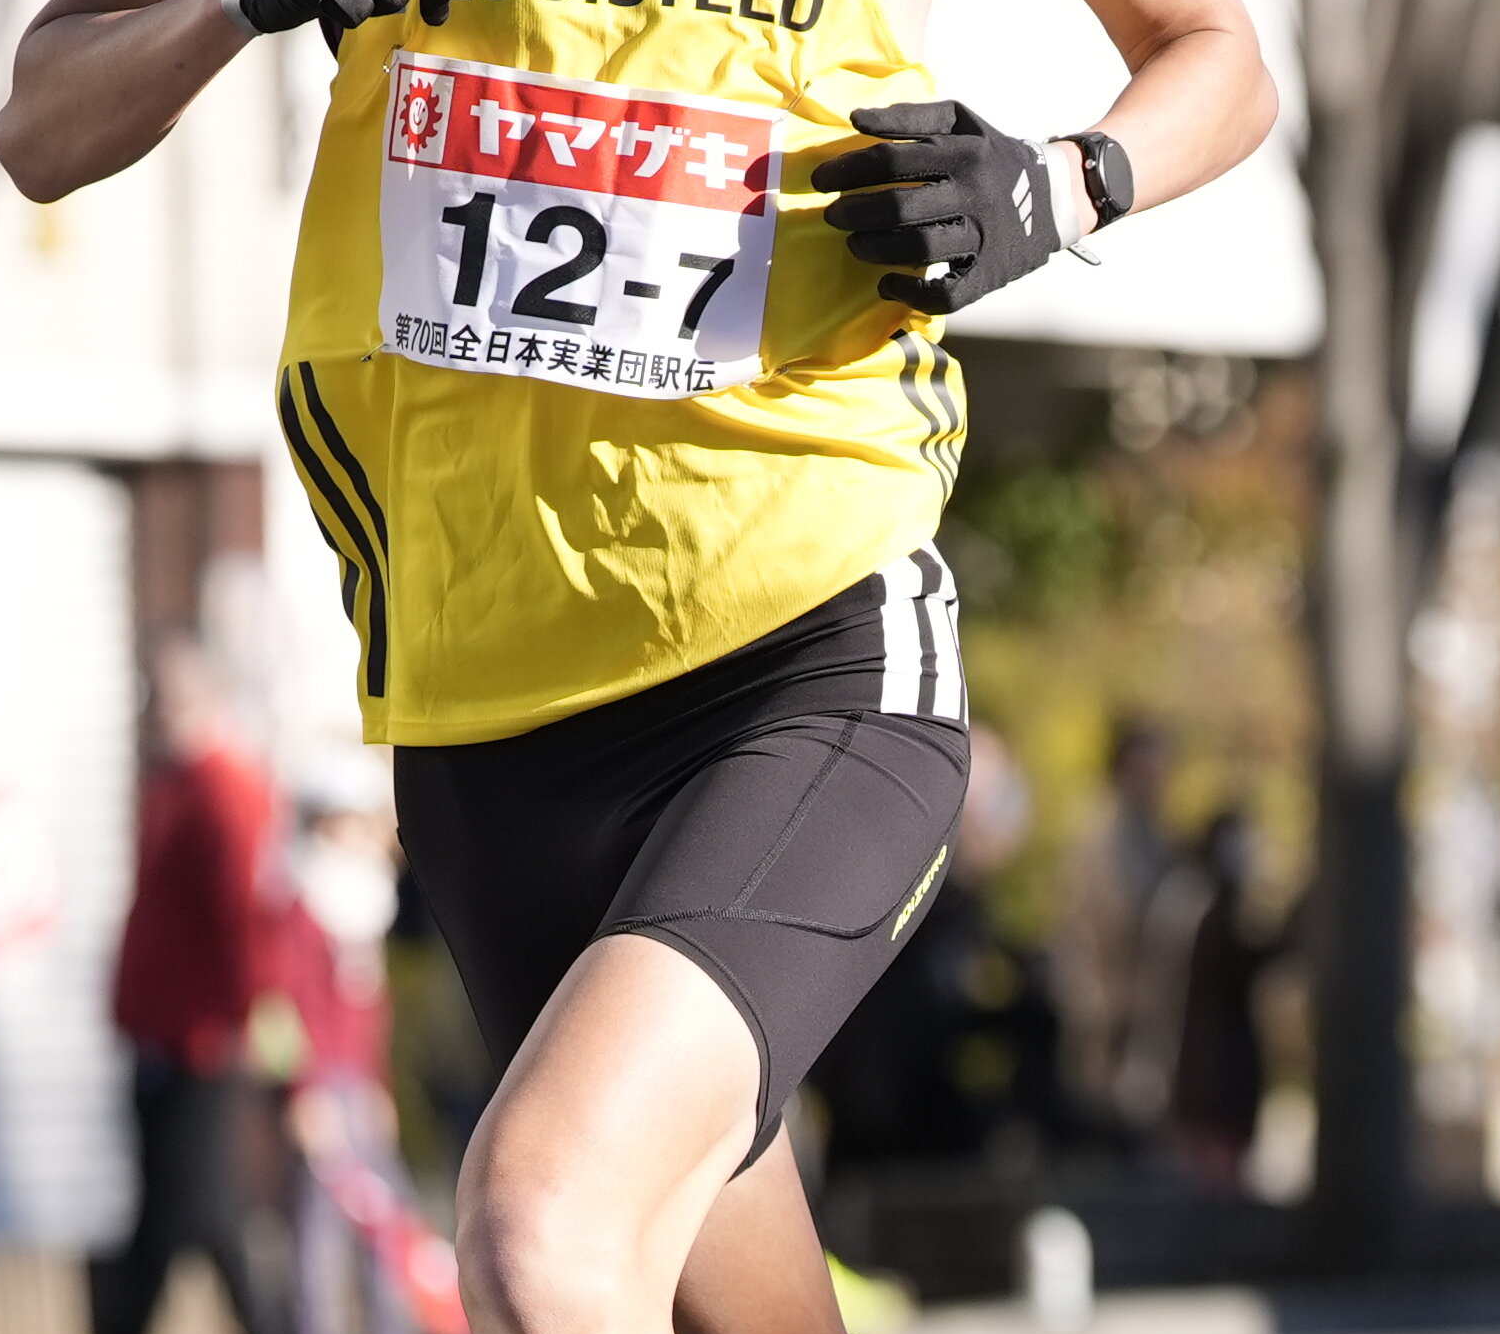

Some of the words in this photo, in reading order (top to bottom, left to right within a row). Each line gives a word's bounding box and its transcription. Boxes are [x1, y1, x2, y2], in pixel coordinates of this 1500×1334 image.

[469, 98, 749, 190] ヤマザキ
[441, 191, 736, 341] 12-7
[395, 312, 716, 393] 第70回全日本実業団駅伝
[890, 844, 948, 942] ADIZERO
